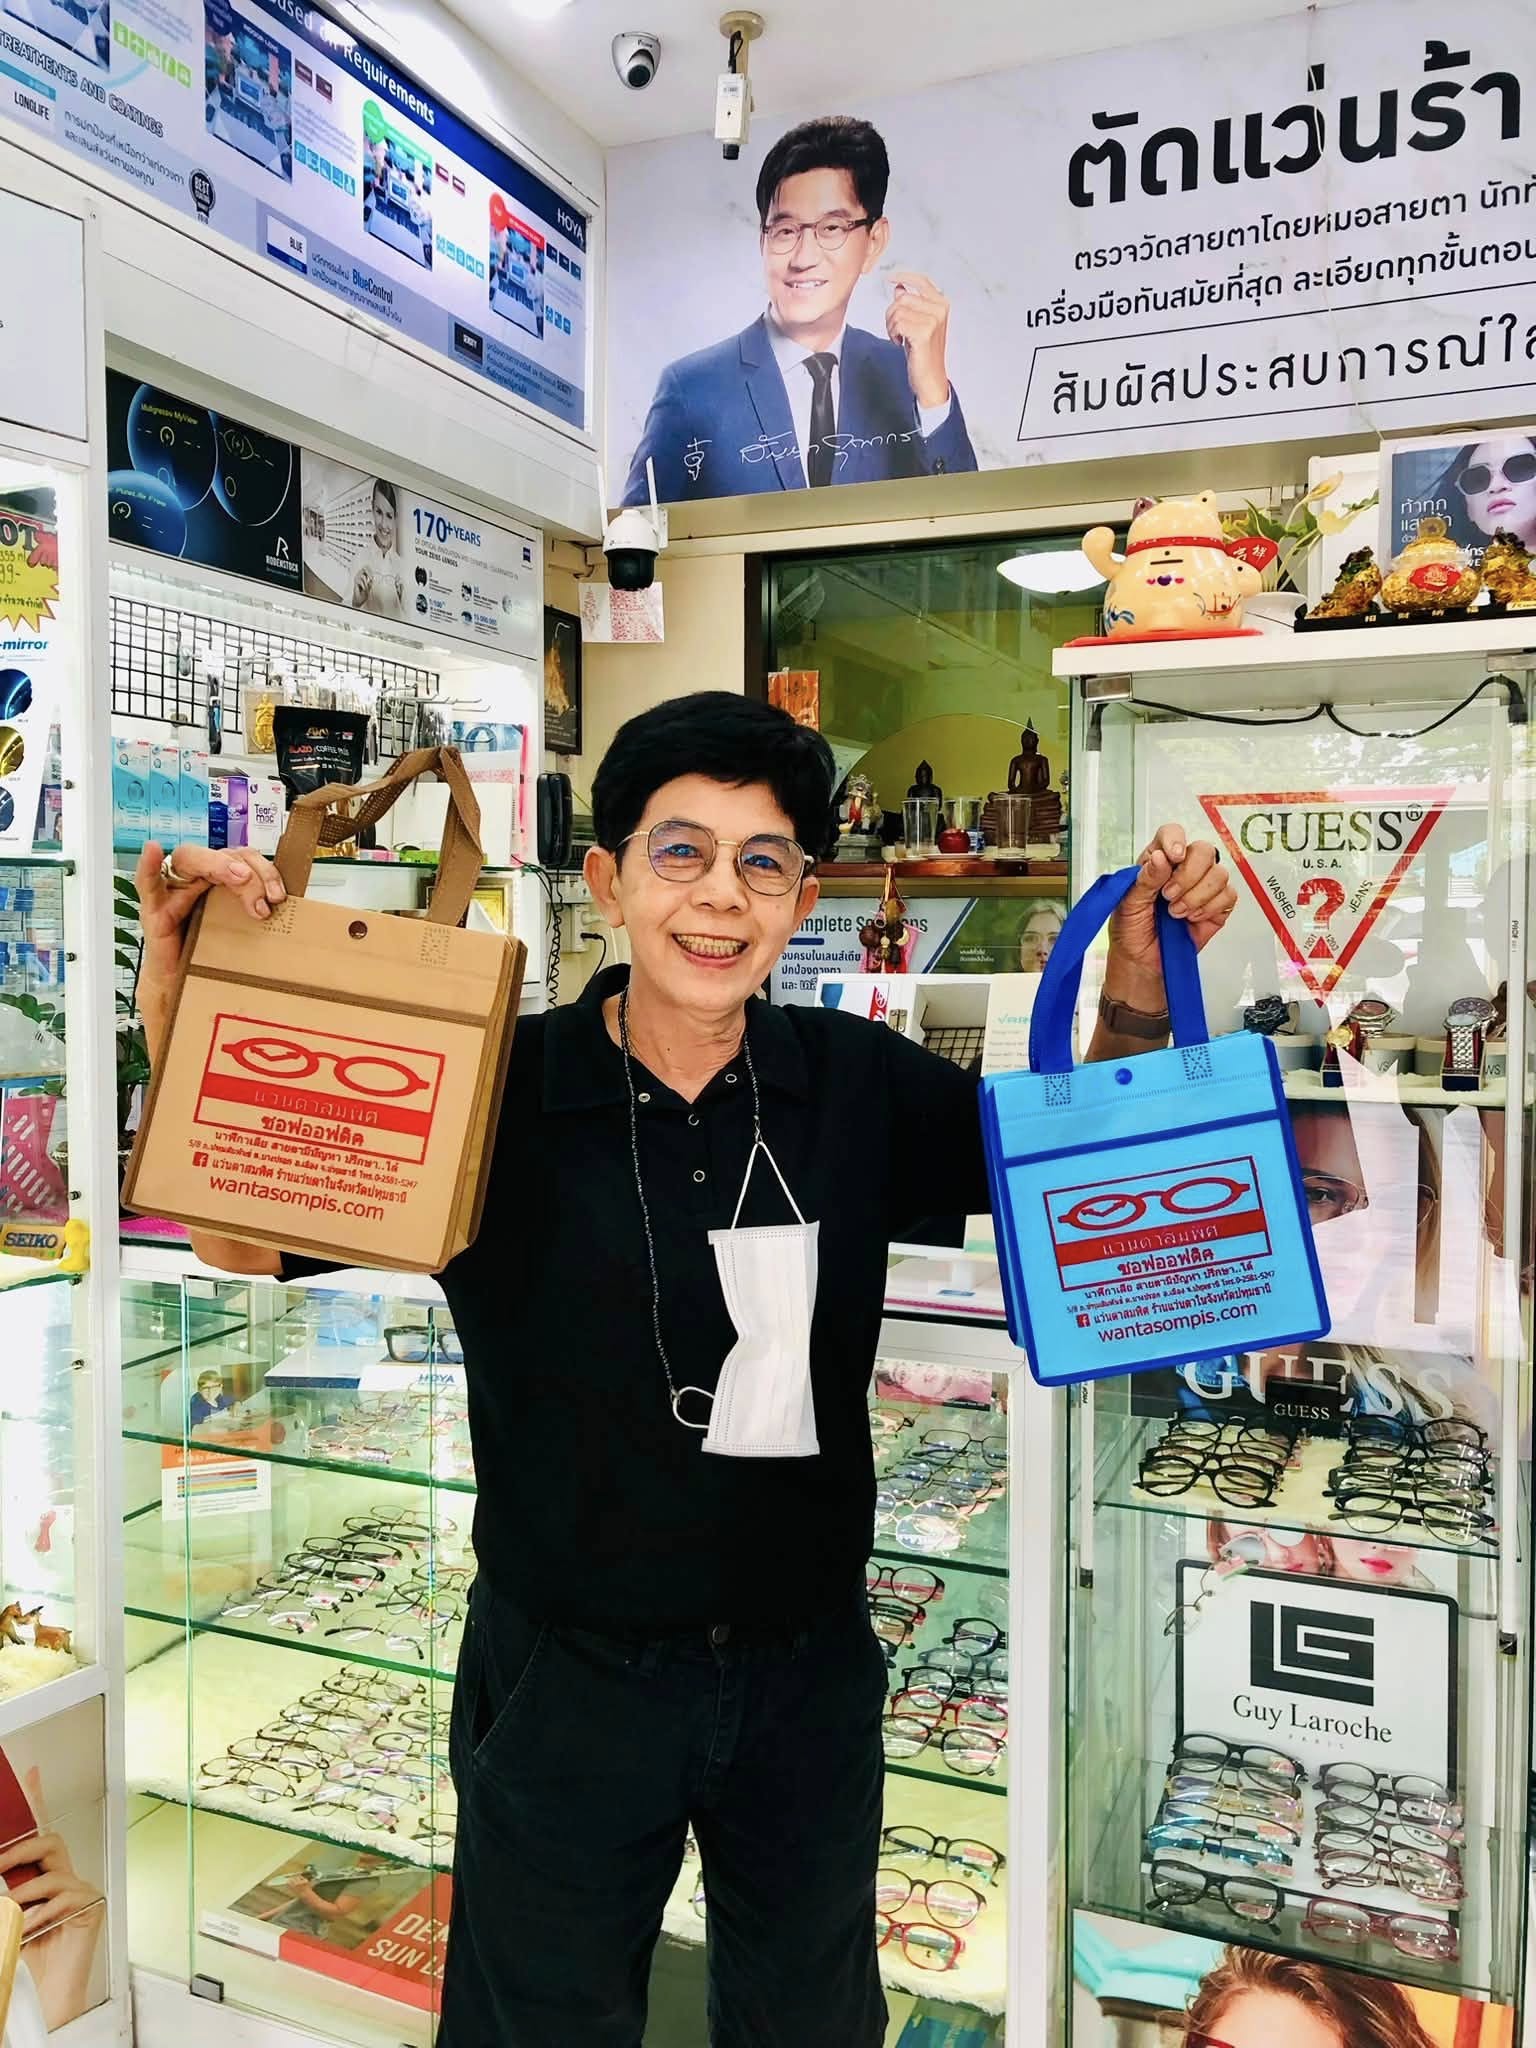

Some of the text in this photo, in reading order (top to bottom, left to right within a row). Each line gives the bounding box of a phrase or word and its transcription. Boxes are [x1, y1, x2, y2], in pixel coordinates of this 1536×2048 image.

[14, 91, 51, 120] LONGLIFE
[80, 77, 106, 104] AND
[109, 93, 164, 138] COATINGS
[343, 47, 435, 126] Requirements
[1068, 40, 1521, 208] ตัดแว่นร้า
[289, 236, 303, 254] BLUE
[557, 207, 585, 241] HOYA
[1074, 192, 1467, 271] ตรวจวัดสายตาโดยหมอสายตา
[352, 269, 394, 305] BlueControl
[1026, 262, 1283, 328] เครื่องมือทันสมัยที่สุด
[454, 524, 481, 548] YEARS
[1240, 809, 1403, 854] GUESS
[1265, 875, 1298, 921] WASHED
[1349, 879, 1374, 914] JEANS
[800, 914, 853, 935] mplete
[209, 1175, 385, 1221] wantasompis.com
[3, 1231, 58, 1250] SEIKO
[1097, 1301, 1258, 1343] wantasompis.com
[1273, 1402, 1331, 1422] GUESS
[1232, 1694, 1393, 1744] Guy Laroche
[367, 1937, 426, 1970] SUN
